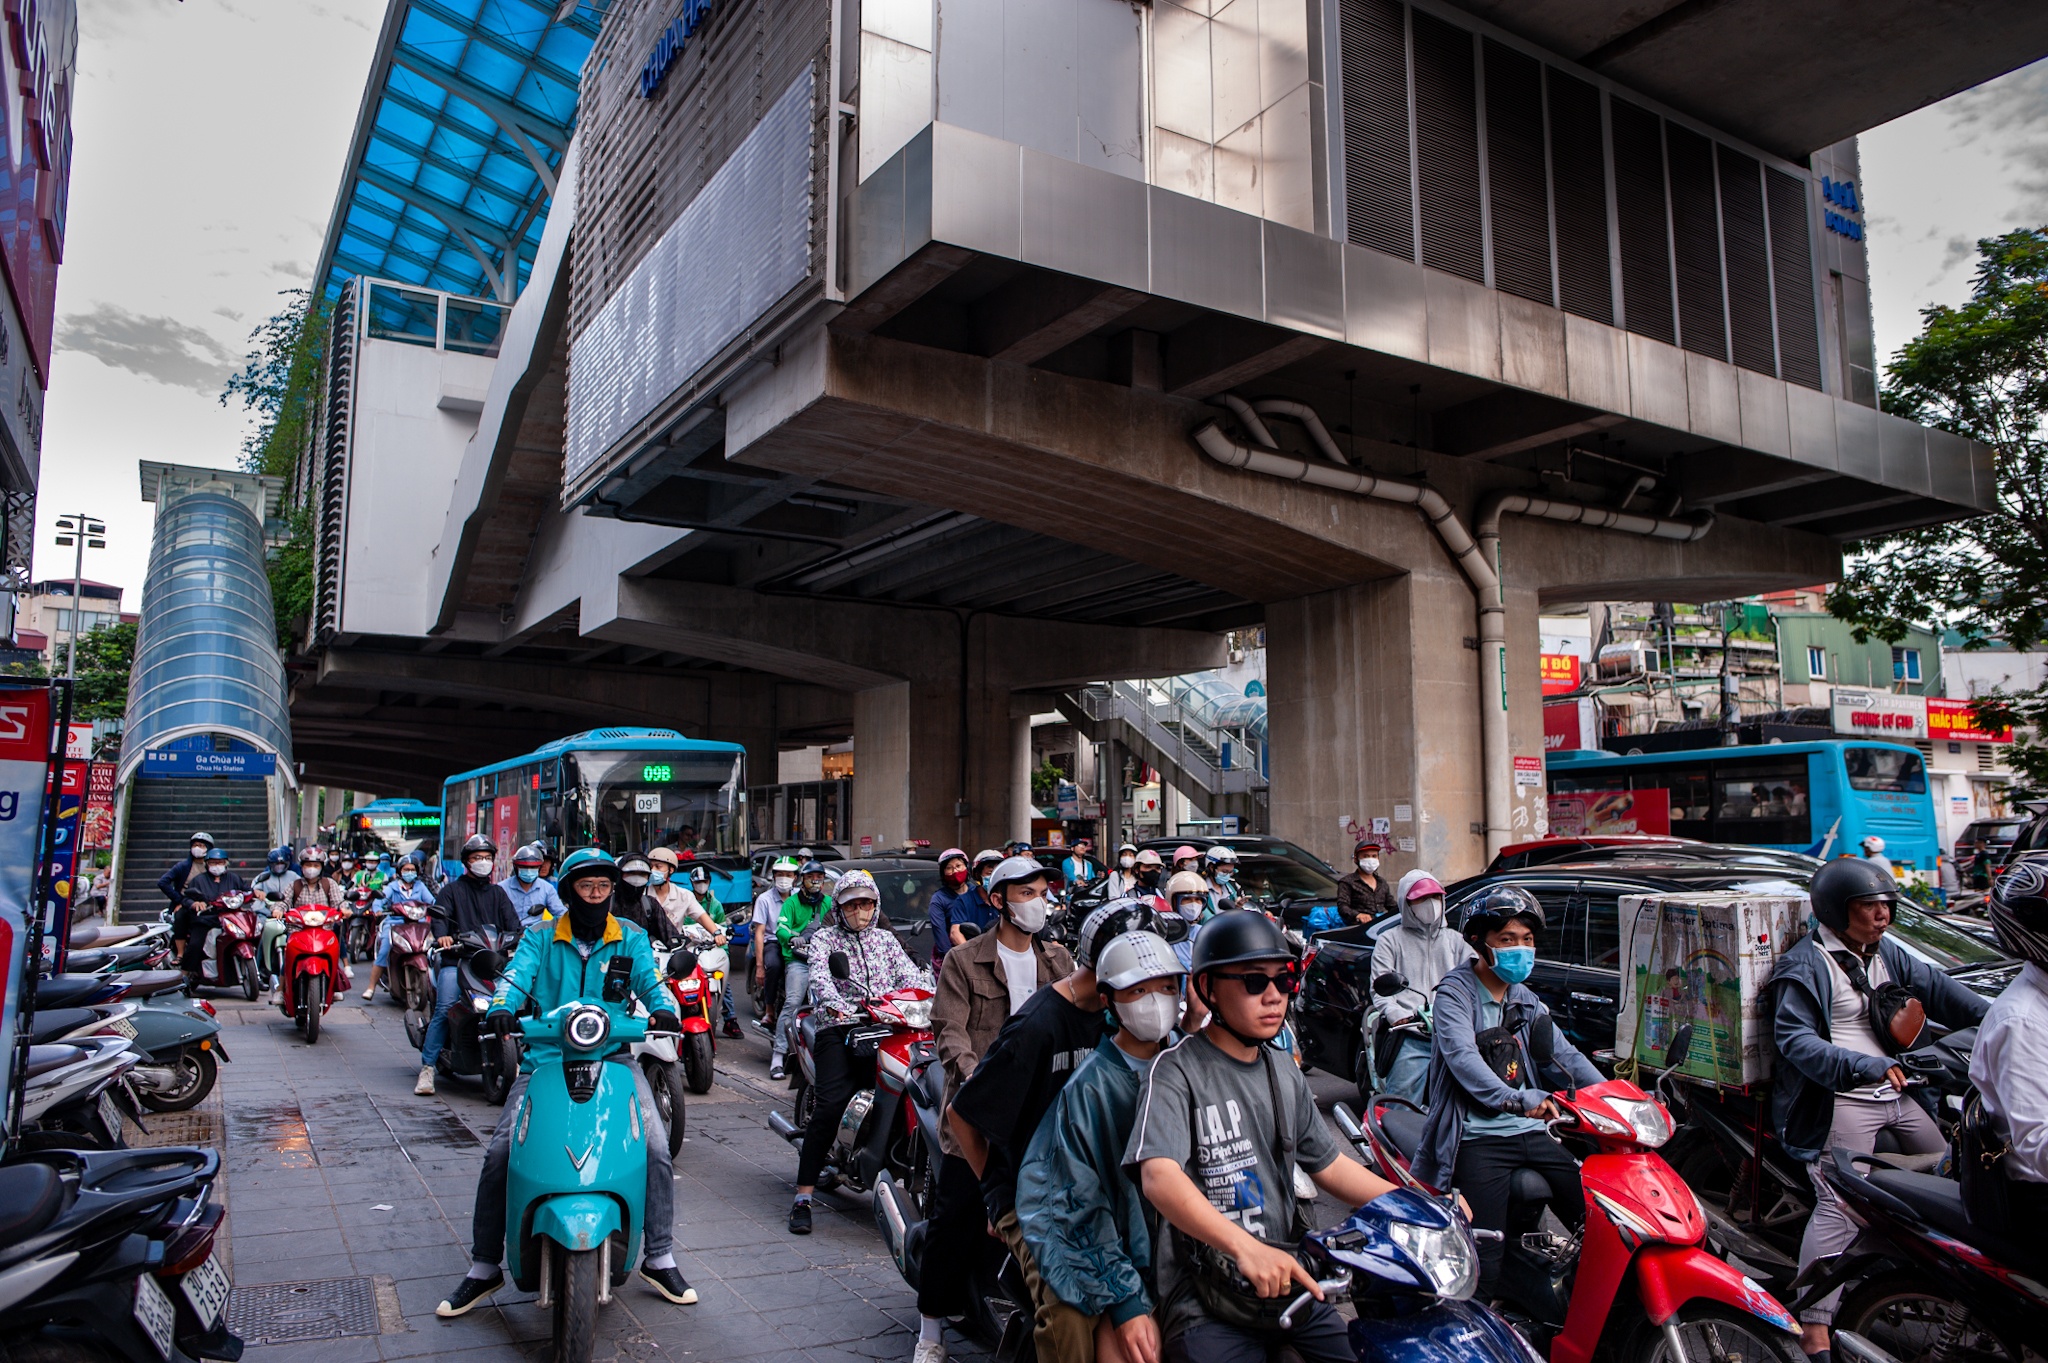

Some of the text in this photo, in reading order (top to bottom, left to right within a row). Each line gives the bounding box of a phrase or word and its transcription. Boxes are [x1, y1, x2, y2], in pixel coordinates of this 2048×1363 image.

[195, 755, 208, 763] Ga
[209, 755, 232, 764] Chùa
[233, 756, 246, 765] Hà
[643, 765, 671, 781] 09B
[638, 797, 659, 810] 09B
[1664, 913, 1696, 926] Kinder
[200, 1273, 228, 1321] 7939
